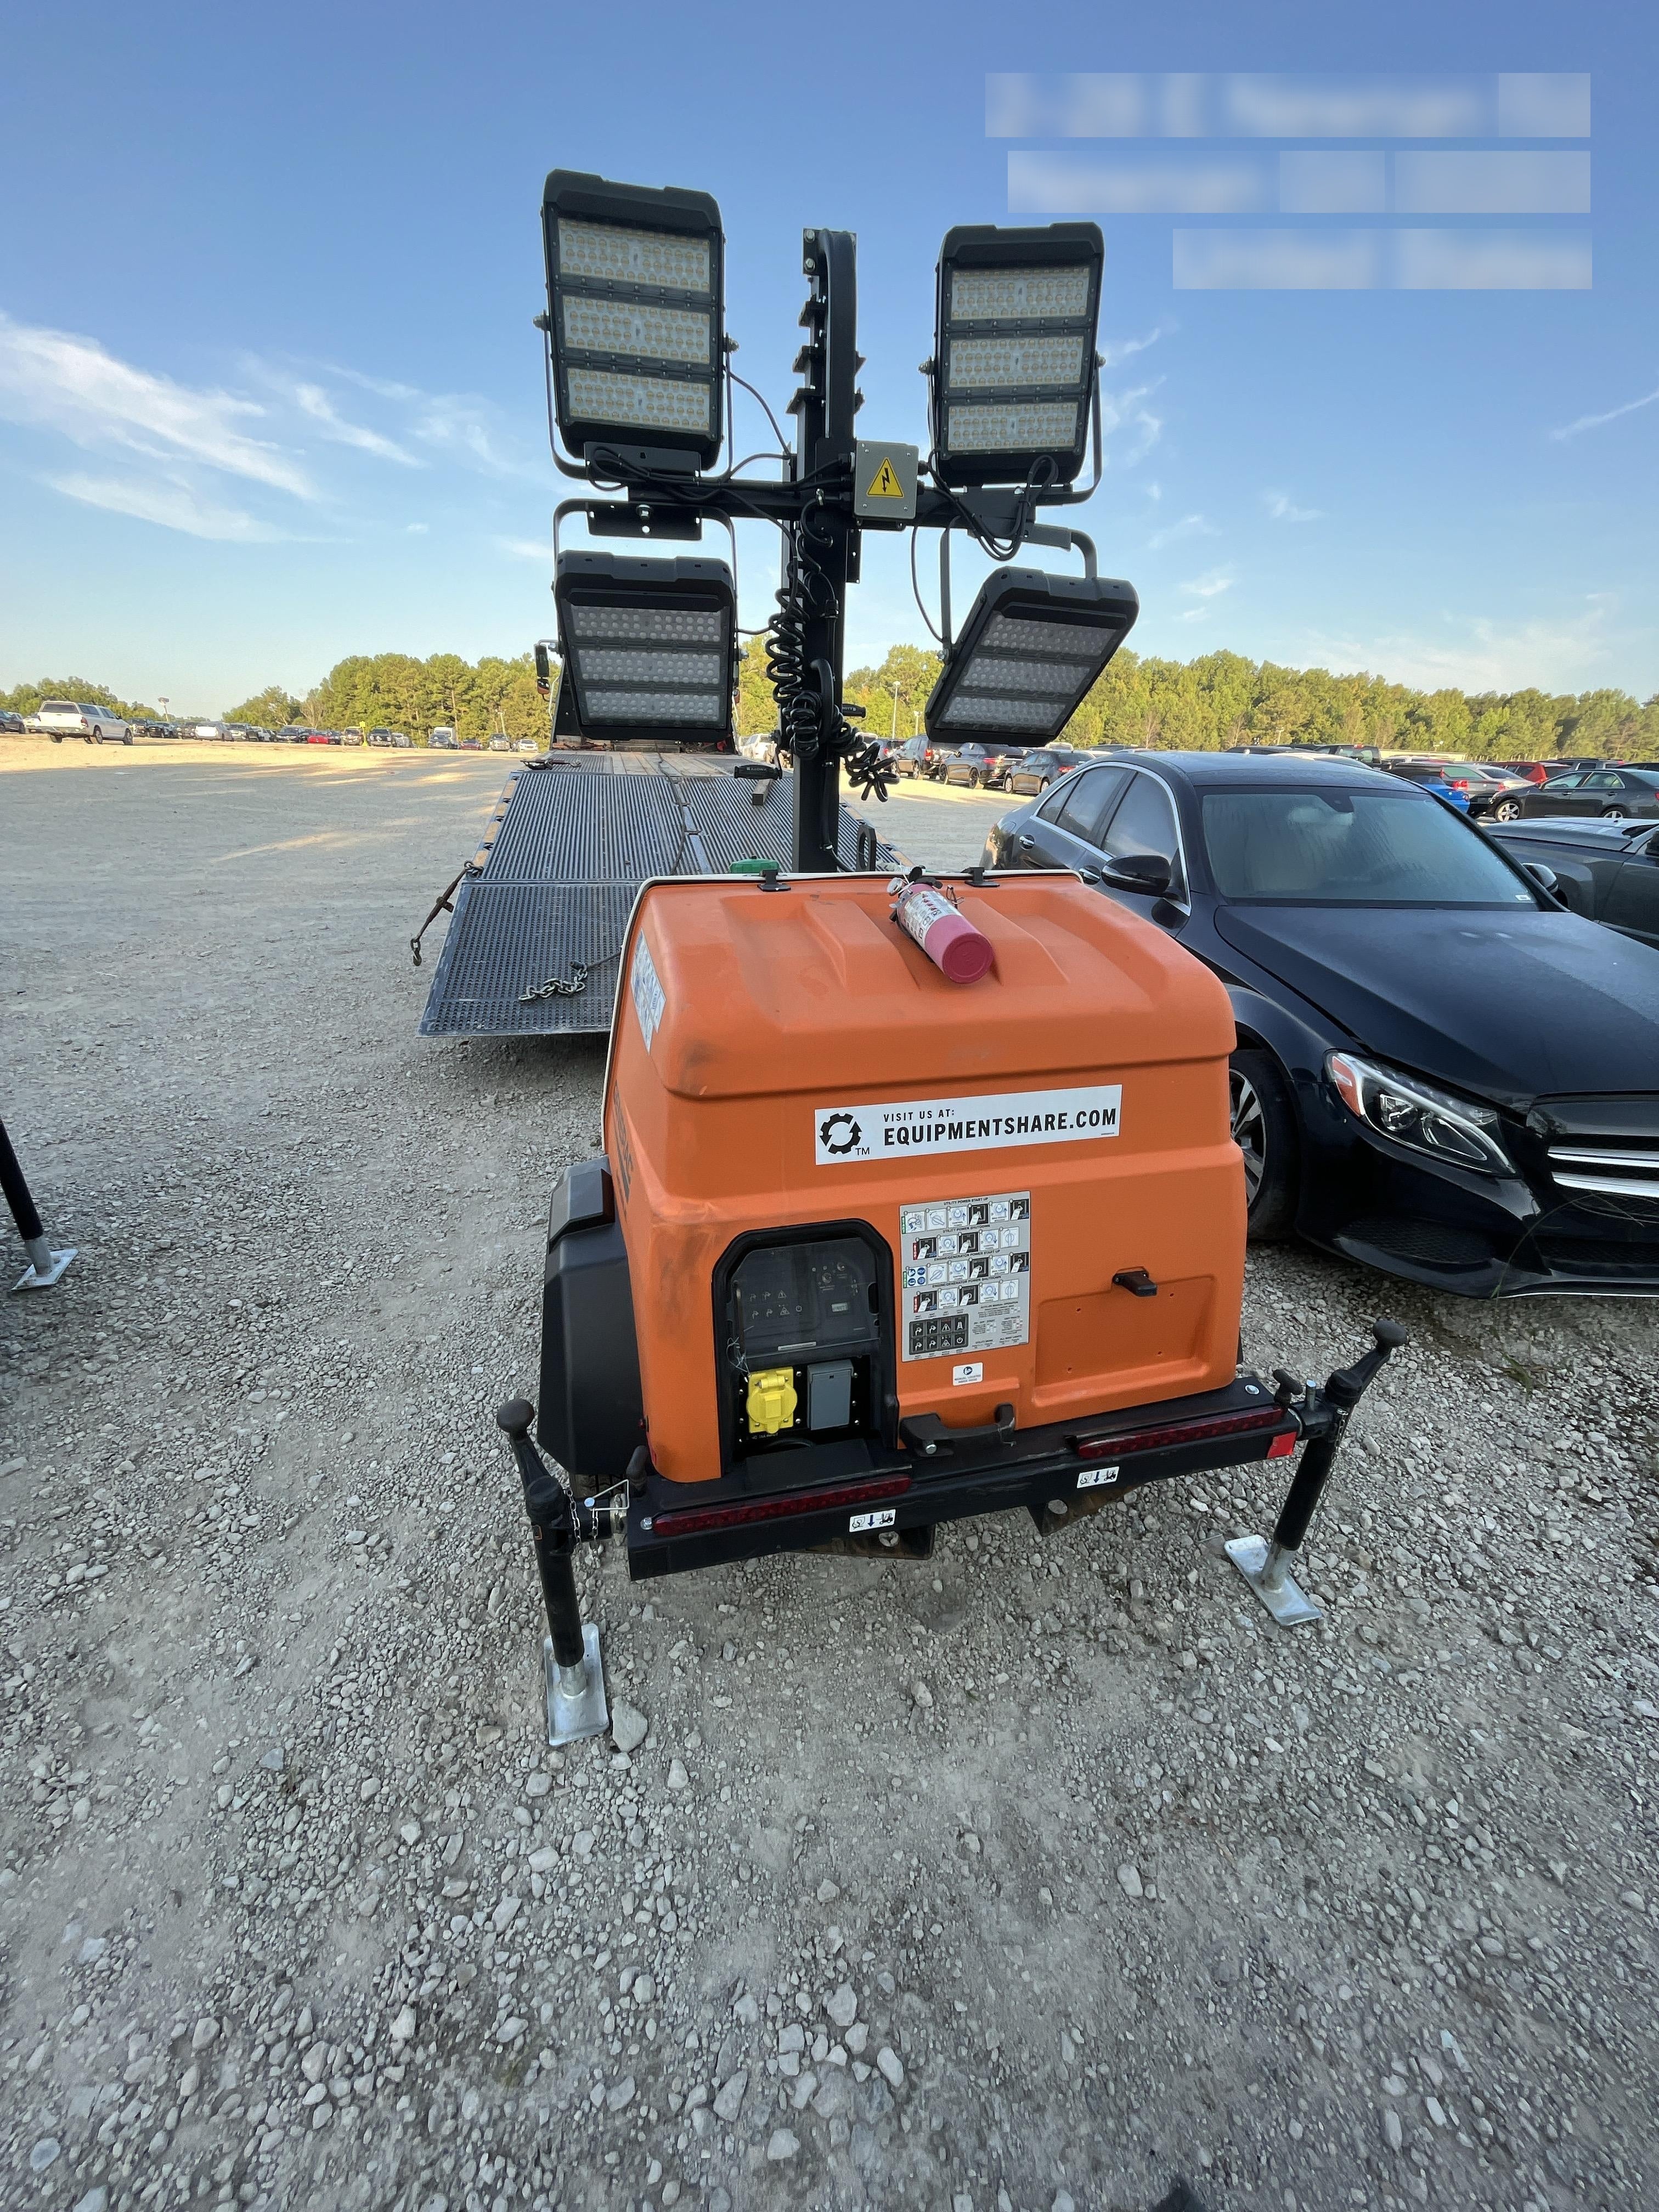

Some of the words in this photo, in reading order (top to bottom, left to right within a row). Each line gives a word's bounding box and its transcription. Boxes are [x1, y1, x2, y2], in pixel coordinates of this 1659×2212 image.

[883, 1111, 913, 1122] VISIT
[919, 1110, 932, 1119] US
[938, 1109, 955, 1118] AT:
[884, 1108, 1116, 1146] EQUIPMENTSHARE.COM
[855, 1147, 870, 1156] TM
